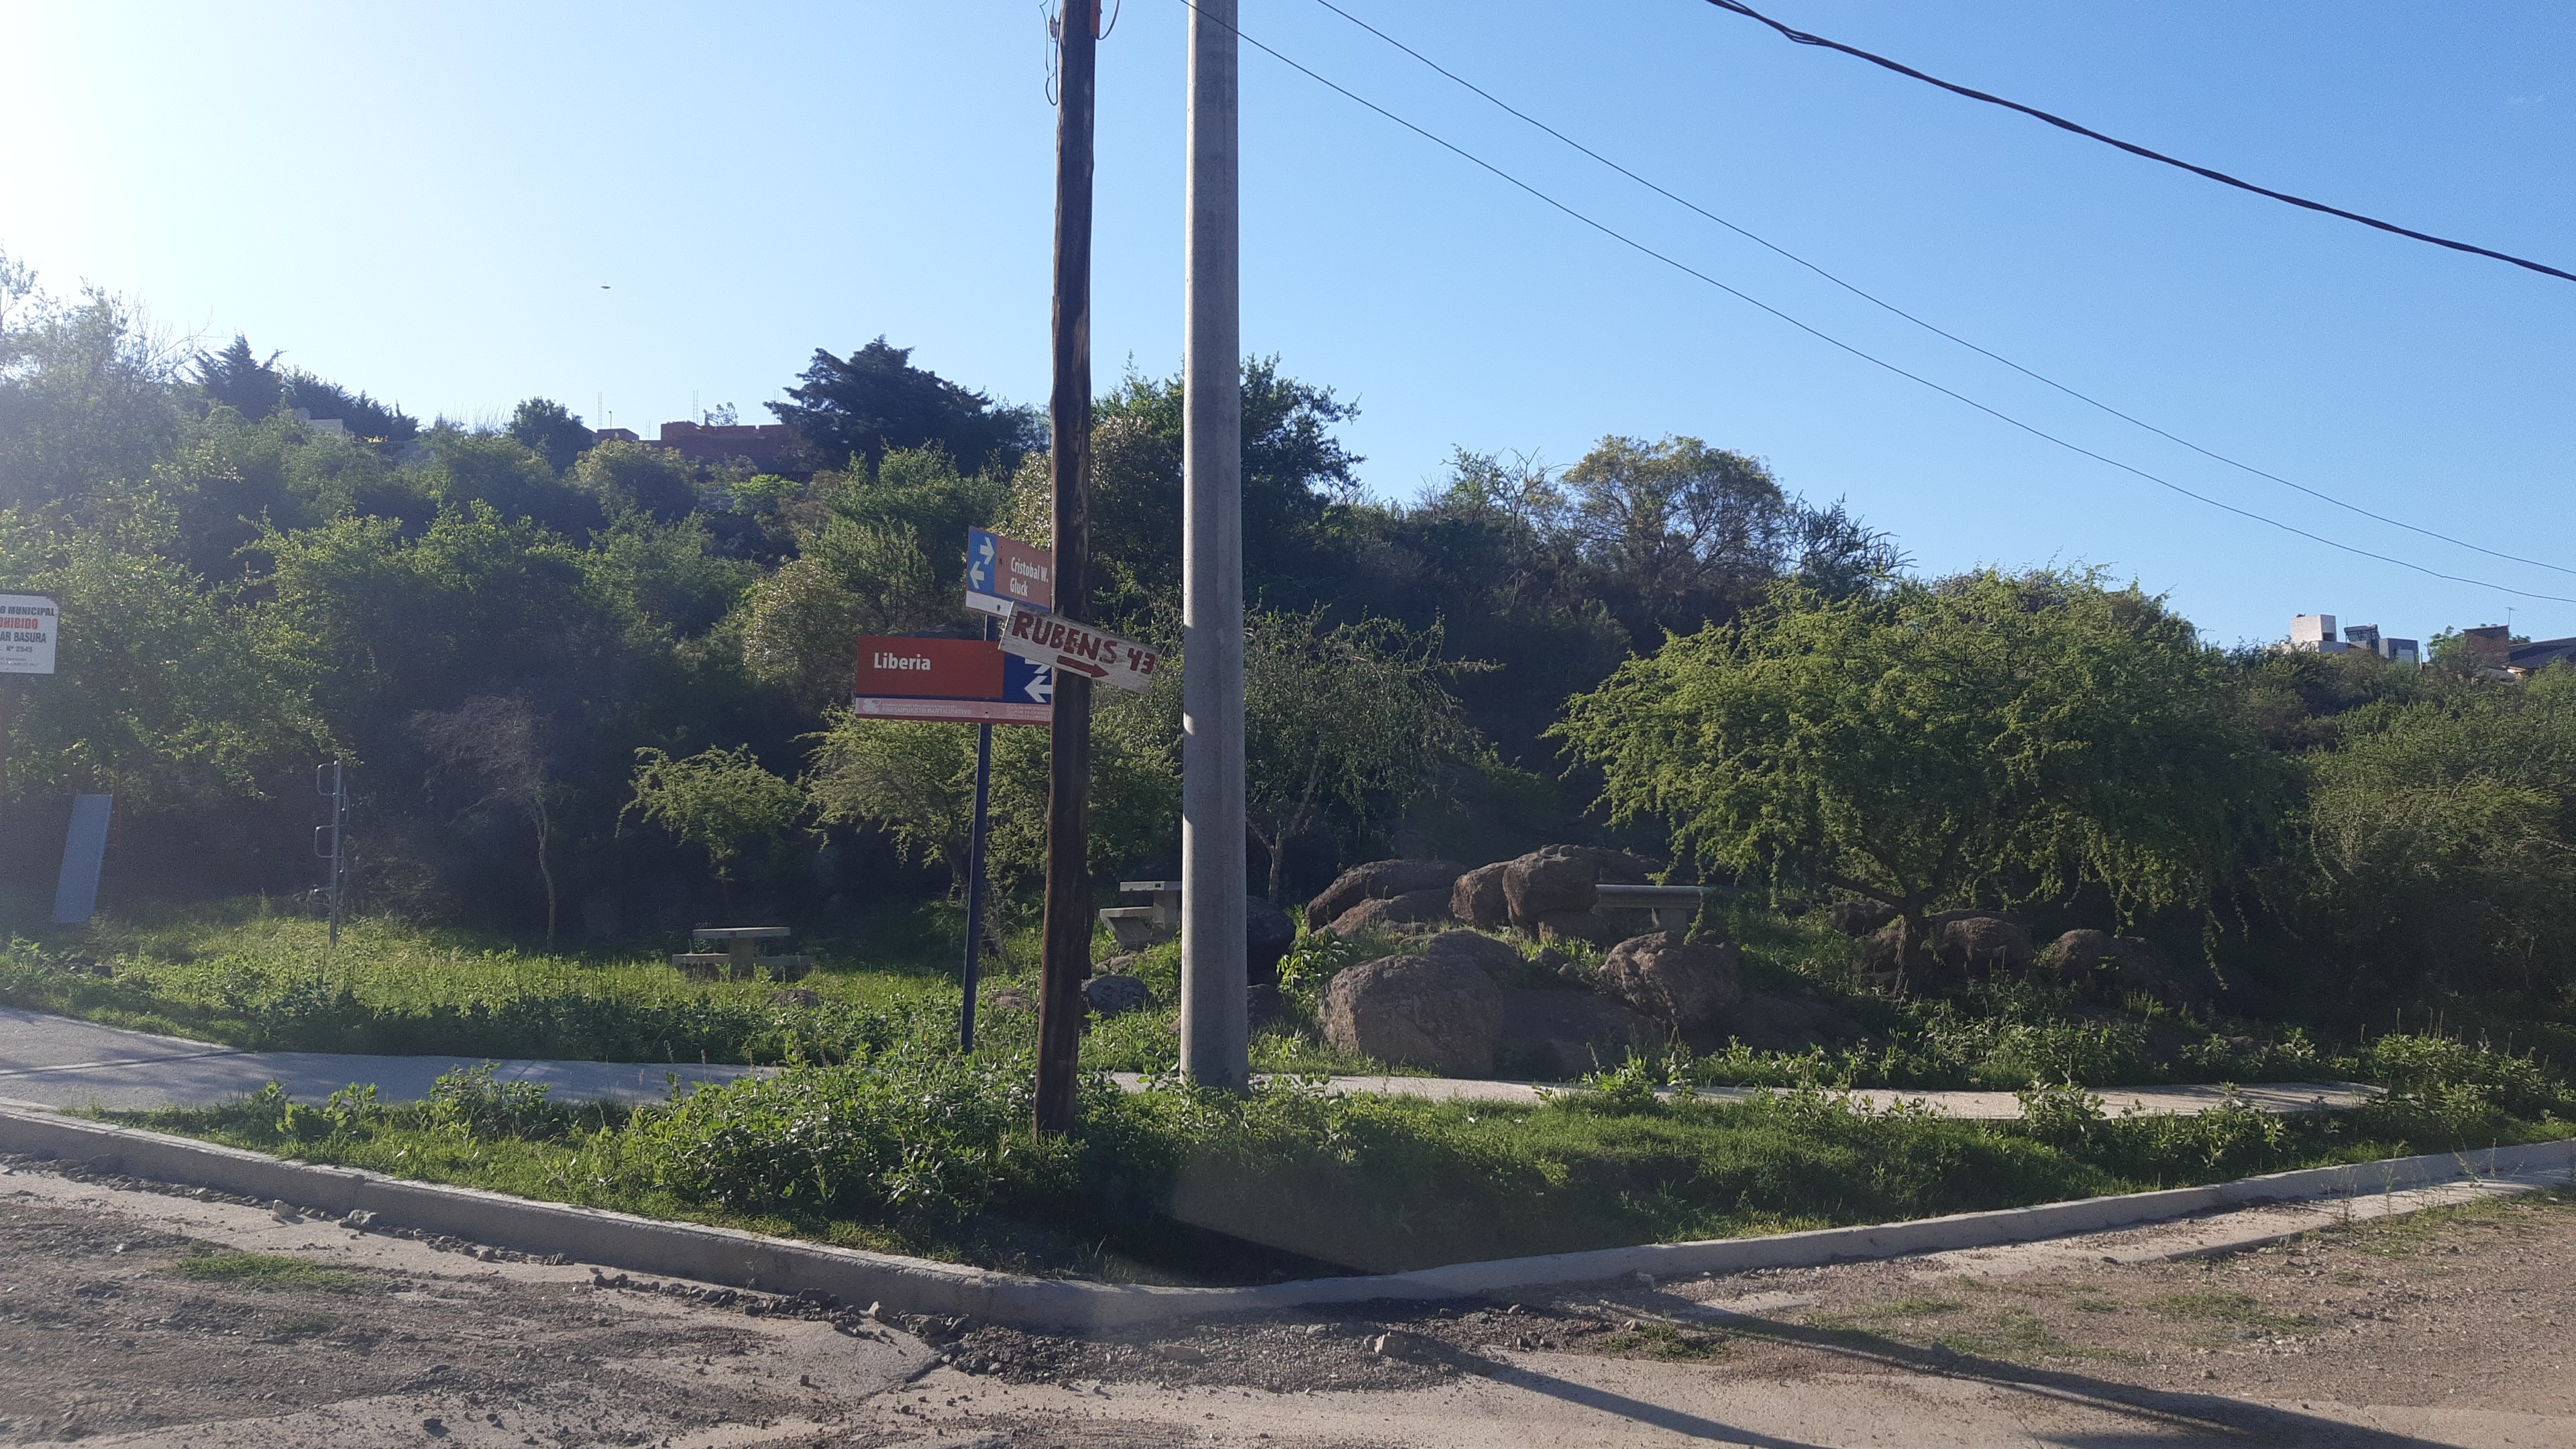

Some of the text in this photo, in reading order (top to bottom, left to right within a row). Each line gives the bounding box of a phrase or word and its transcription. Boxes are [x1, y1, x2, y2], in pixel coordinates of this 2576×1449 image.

[1011, 556, 1049, 583] Cristobal W.
[1010, 577, 1028, 597] Gluck
[8, 606, 55, 616] MUNICIPAL
[14, 632, 47, 643] BASURA
[1012, 610, 1157, 675] RUBENS 43
[873, 652, 931, 670] Liberia
